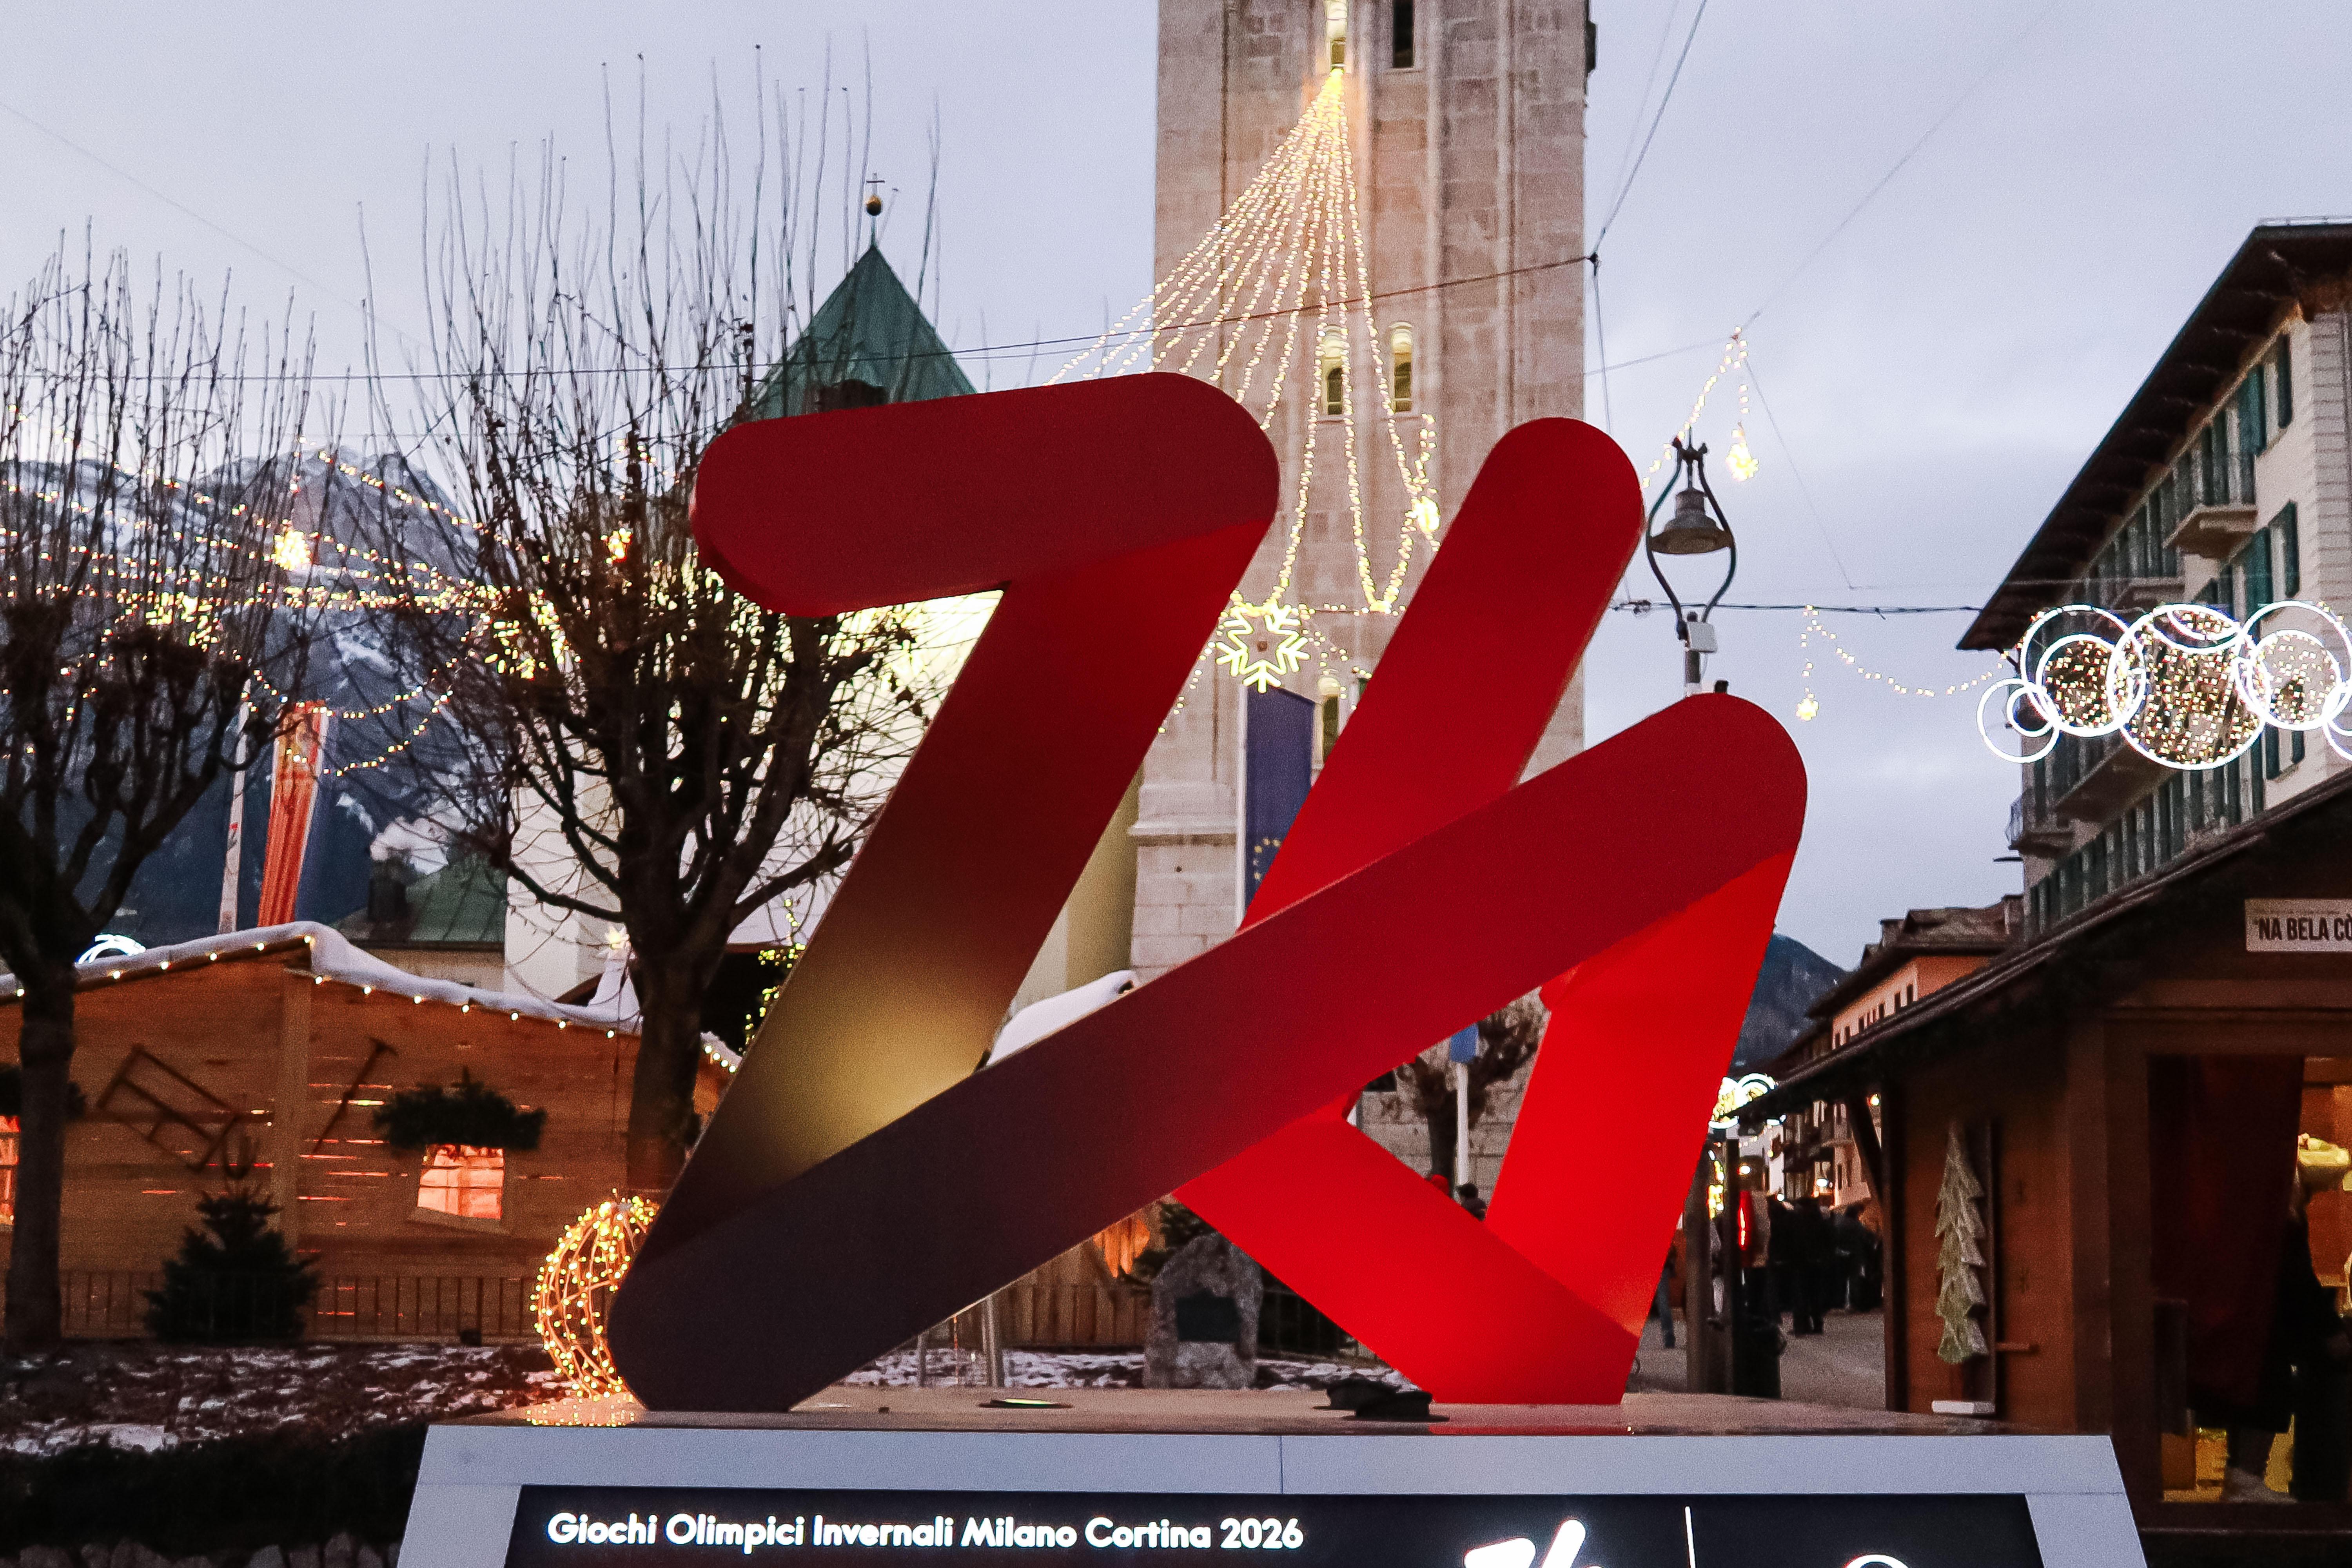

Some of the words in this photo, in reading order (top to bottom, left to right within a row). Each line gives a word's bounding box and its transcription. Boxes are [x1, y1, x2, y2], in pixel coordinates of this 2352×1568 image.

[2286, 917, 2329, 940] BELA
[547, 1512, 659, 1545] Giochi
[665, 1512, 806, 1555] Olimpici
[813, 1514, 955, 1548] Invernali
[960, 1515, 1078, 1548] Milano
[1084, 1516, 1212, 1549] Cortina
[1220, 1517, 1305, 1550] 2026
